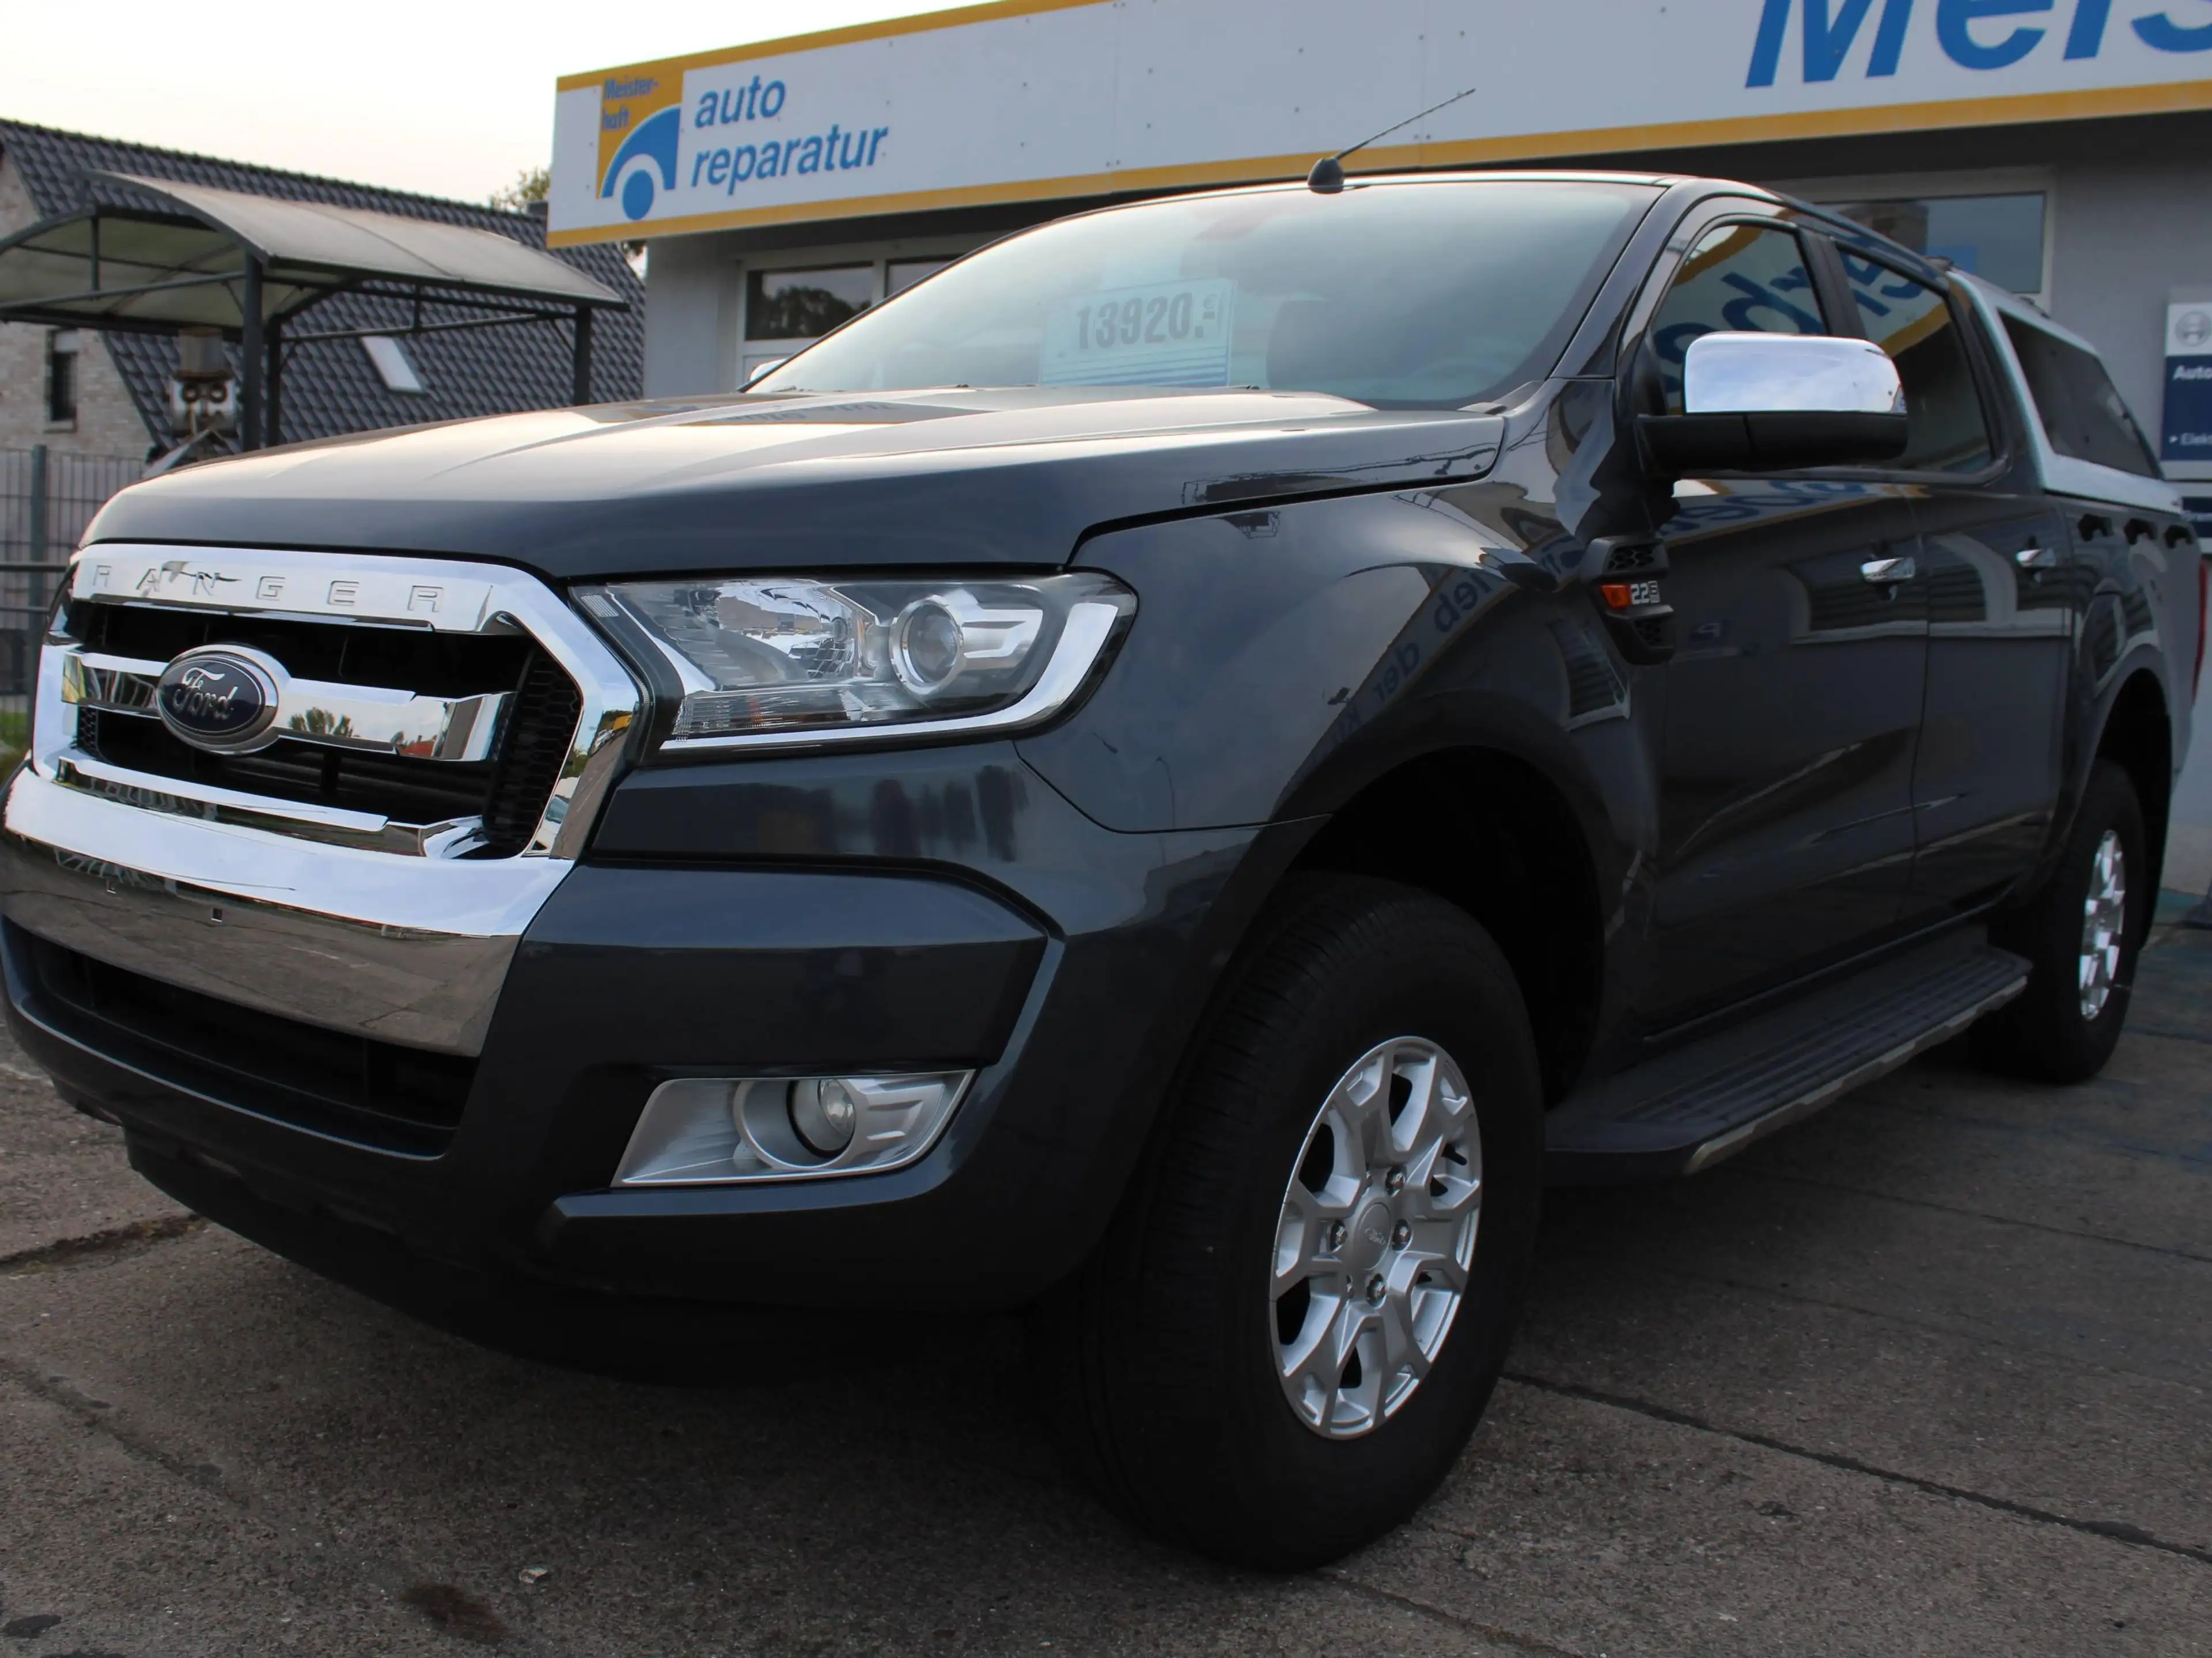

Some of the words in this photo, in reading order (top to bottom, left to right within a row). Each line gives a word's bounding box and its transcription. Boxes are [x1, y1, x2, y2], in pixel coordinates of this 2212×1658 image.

[695, 75, 787, 128] auto
[692, 124, 889, 196] reparatur
[93, 565, 444, 613] RANGER
[174, 667, 239, 720] Ford
